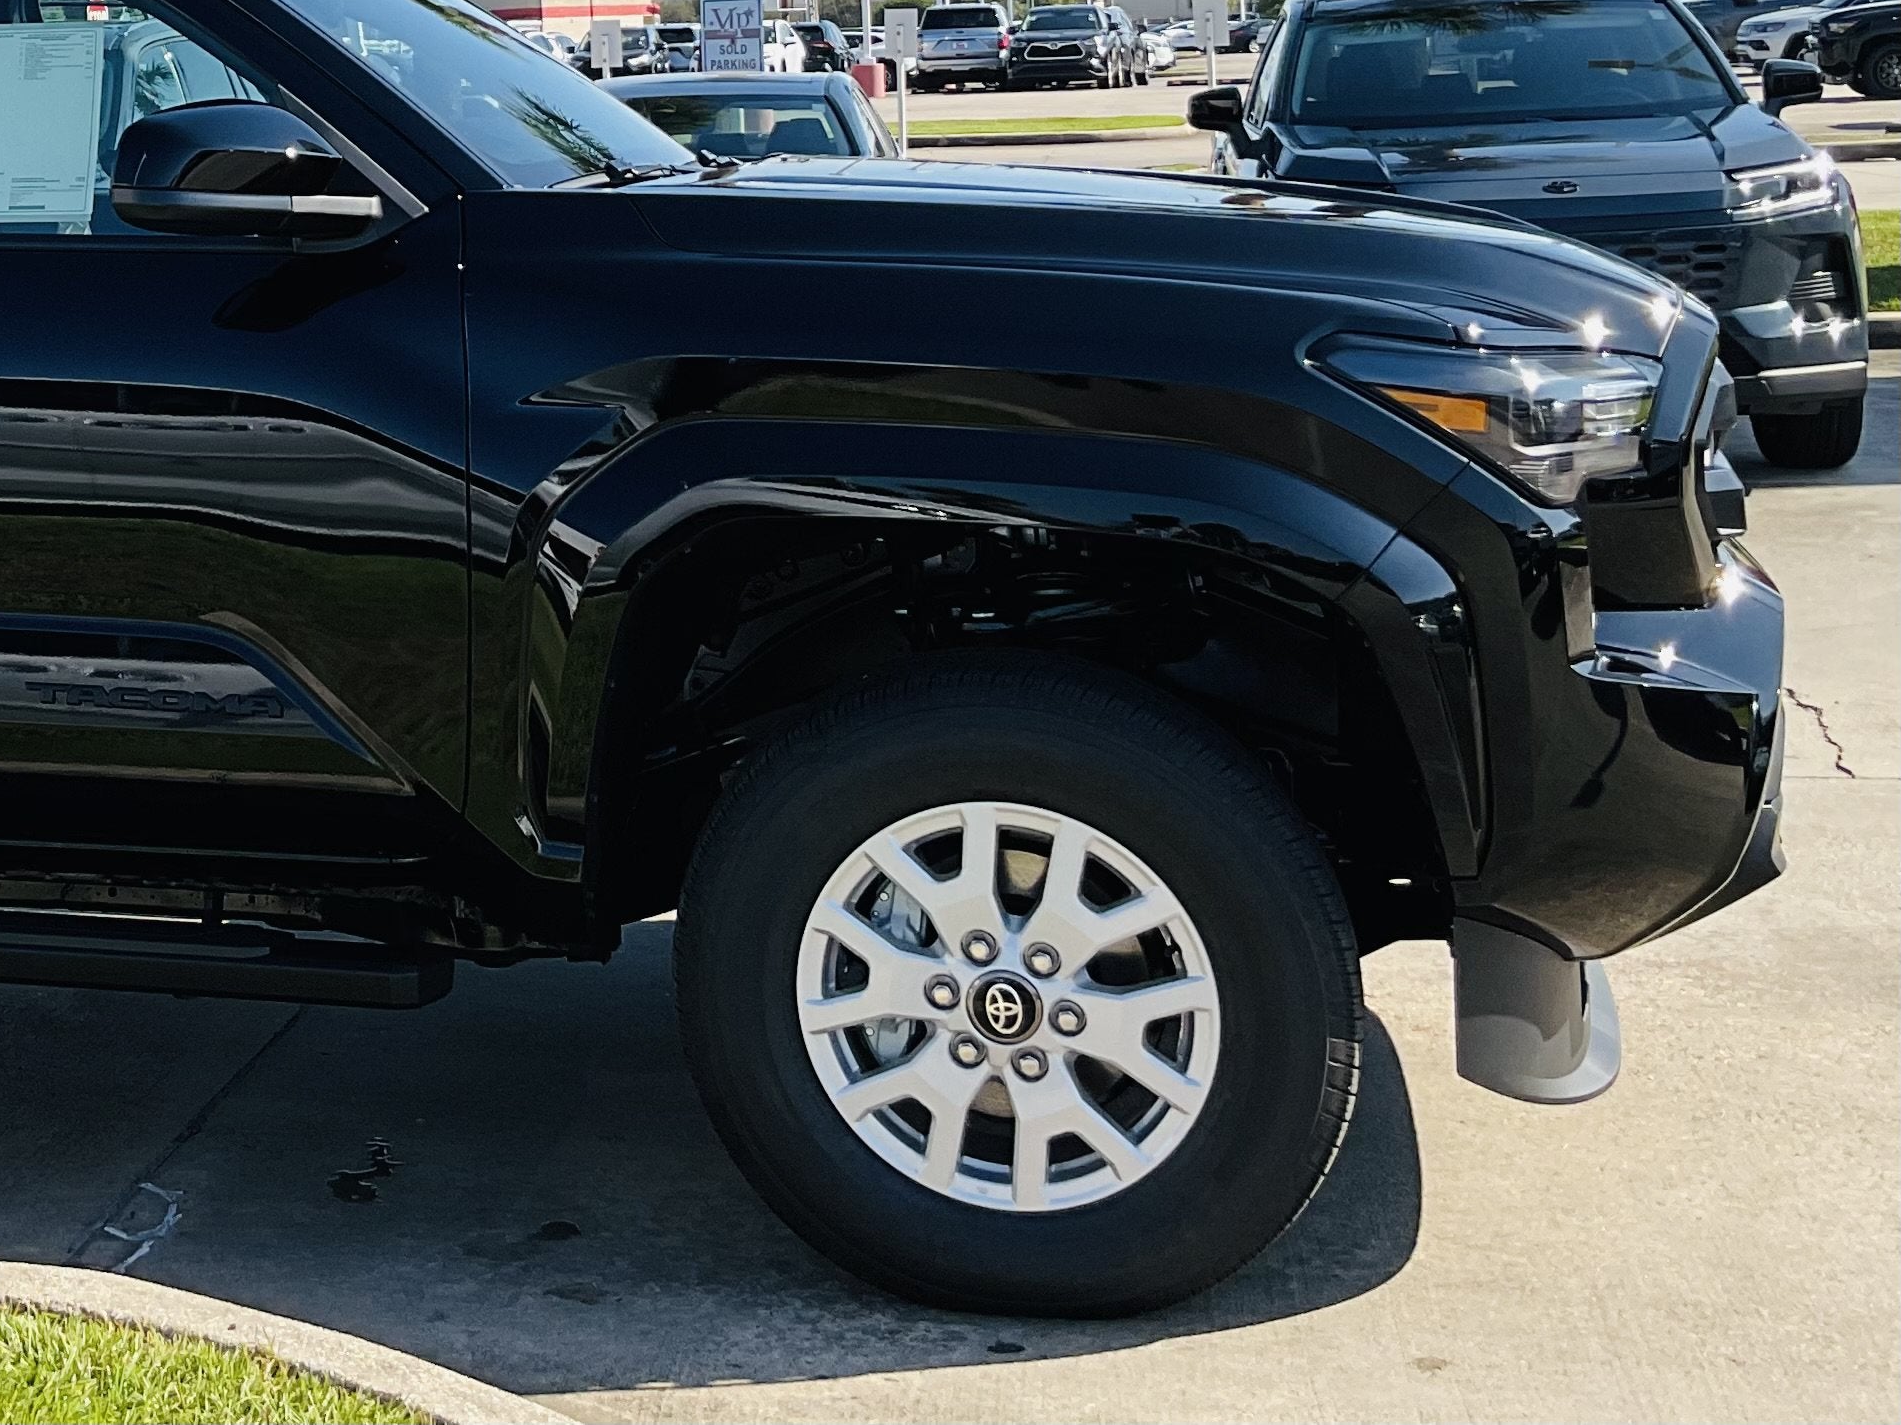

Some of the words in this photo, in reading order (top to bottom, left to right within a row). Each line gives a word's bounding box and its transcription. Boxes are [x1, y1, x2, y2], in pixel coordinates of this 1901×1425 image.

[719, 44, 747, 55] SOLD
[710, 59, 756, 70] PARKING
[25, 681, 285, 718] TACOMA
